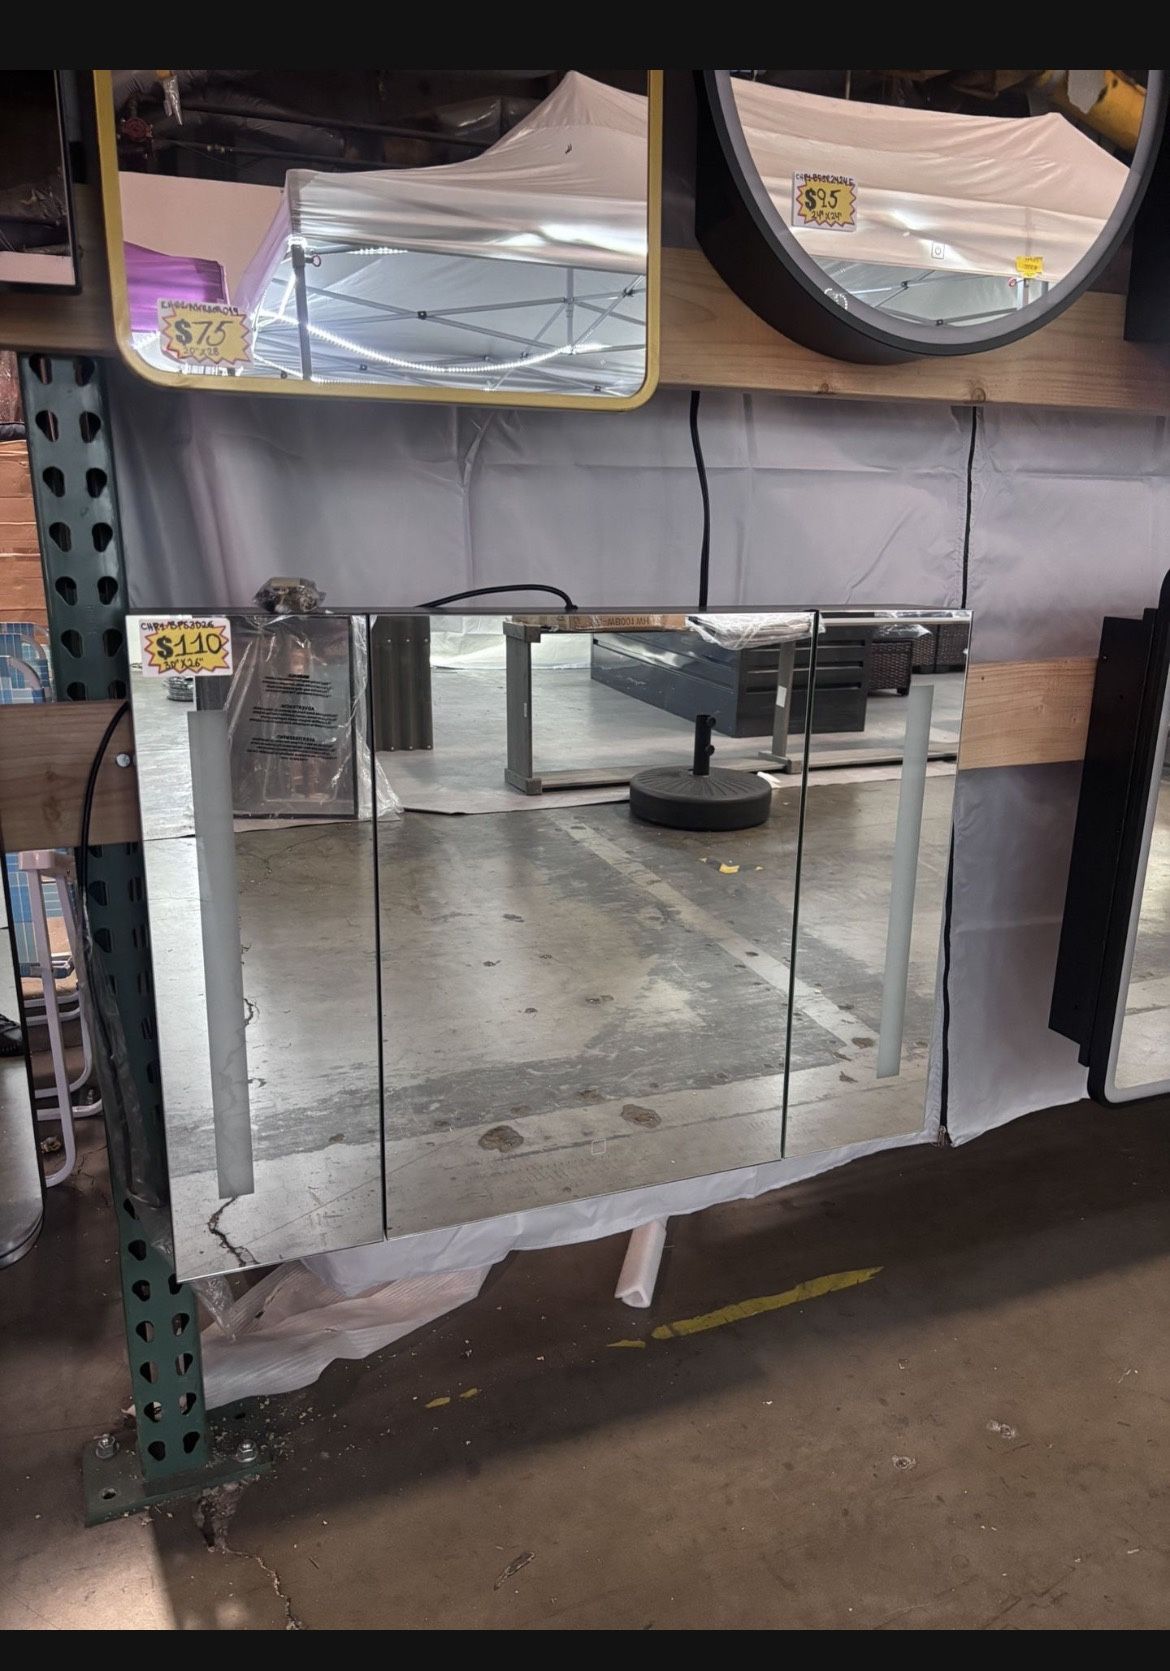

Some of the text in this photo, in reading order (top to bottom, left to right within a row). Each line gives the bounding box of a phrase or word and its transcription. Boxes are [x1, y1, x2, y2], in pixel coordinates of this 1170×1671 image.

[805, 188, 841, 211] $95
[174, 318, 234, 346] $75
[156, 632, 222, 660] $110
